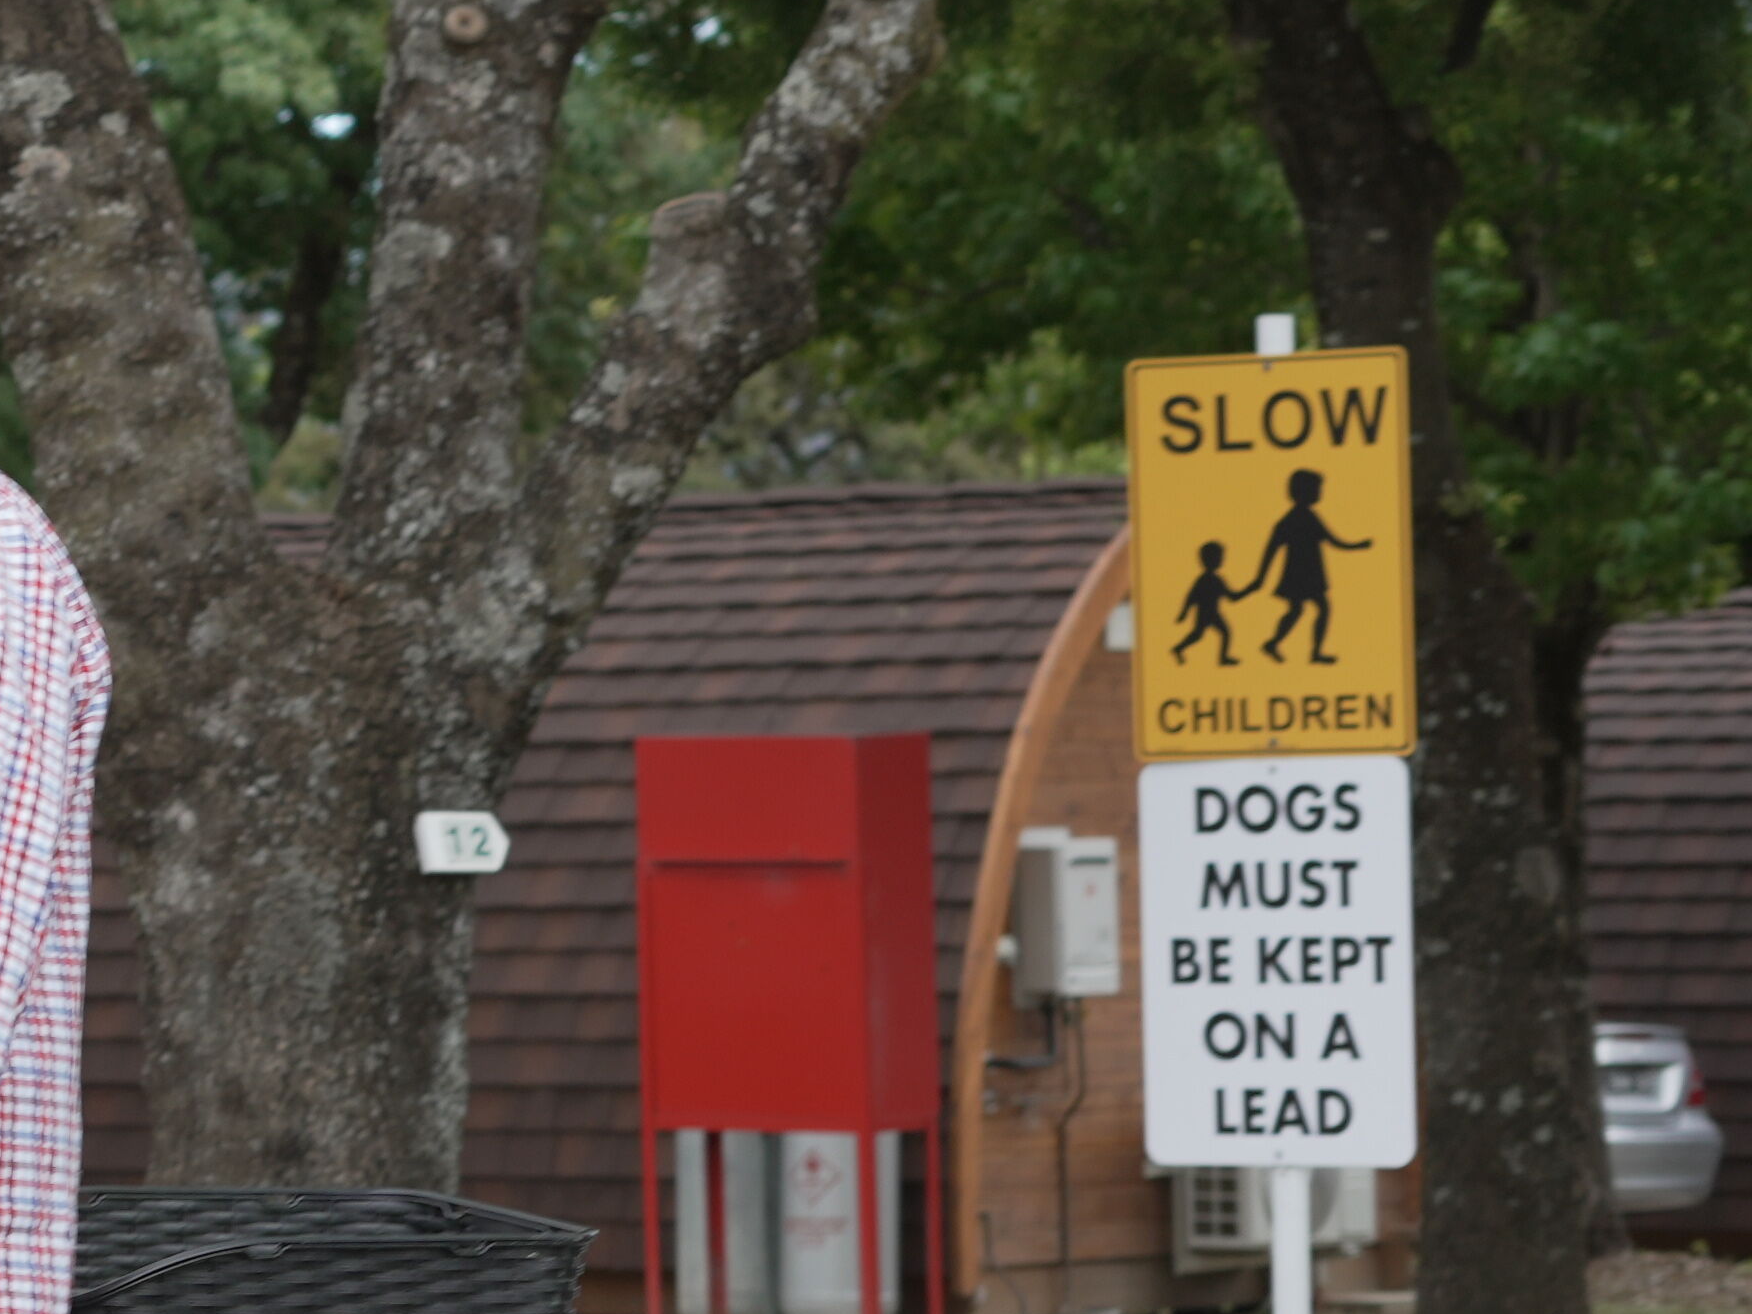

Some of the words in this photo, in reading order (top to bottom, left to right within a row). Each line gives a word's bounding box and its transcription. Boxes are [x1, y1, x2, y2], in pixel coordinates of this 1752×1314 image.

[1160, 385, 1389, 454] SLOW
[1157, 694, 1394, 736] CHILDREN
[1194, 783, 1362, 834] DOGS
[443, 824, 493, 859] 12
[1201, 860, 1359, 909] MUST
[1171, 939, 1233, 984] BE
[1257, 936, 1393, 983] KEPT
[1205, 1013, 1296, 1061] ON
[1322, 1014, 1361, 1061] A
[1215, 1087, 1353, 1138] LEAD
